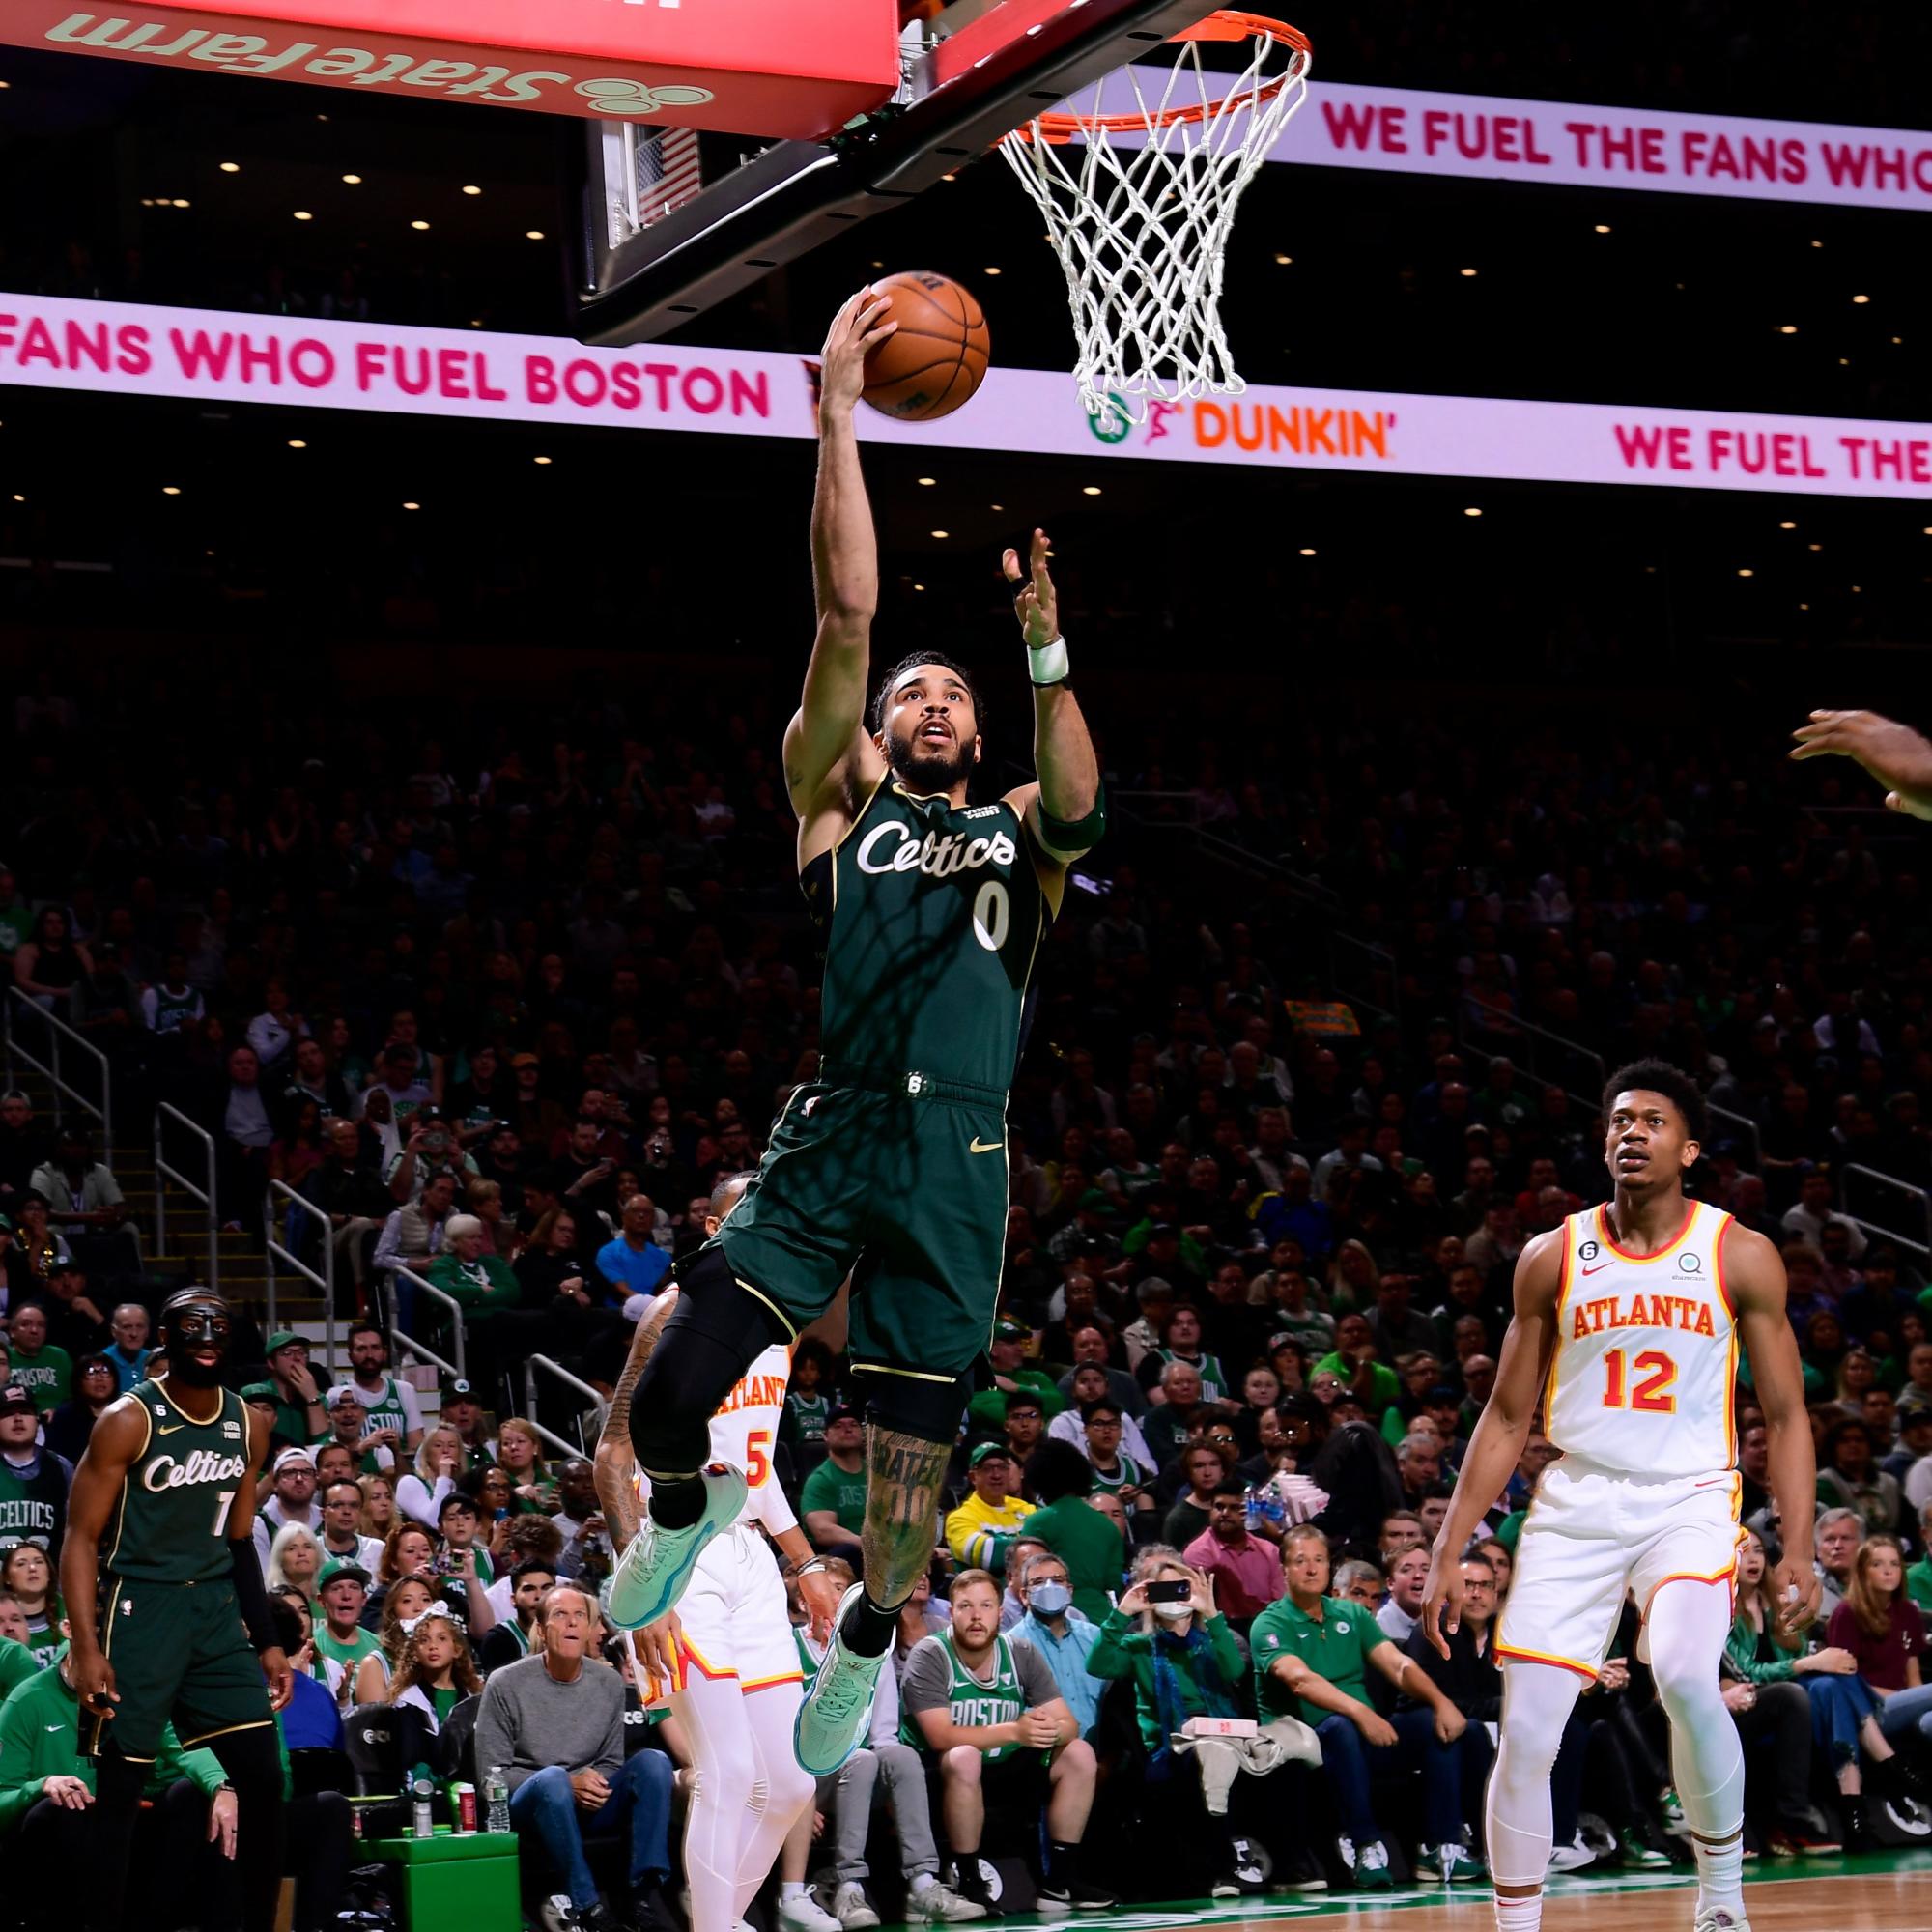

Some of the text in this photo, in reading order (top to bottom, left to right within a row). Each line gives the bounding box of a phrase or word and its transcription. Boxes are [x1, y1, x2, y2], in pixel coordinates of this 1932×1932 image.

[1321, 101, 1406, 154] WE
[1423, 111, 1551, 165] FUEL
[1565, 123, 1666, 174] THE
[1682, 132, 1807, 185] FANS
[168, 328, 334, 387] WHO
[355, 343, 506, 401] FUEL
[525, 355, 768, 417] BOSTON
[1194, 401, 1395, 458] DUNKIN'
[1614, 425, 1932, 483] WE FUEL THE
[857, 820, 1017, 878] Celtics
[973, 881, 1009, 952] 0
[908, 1076, 922, 1093] 6
[1574, 1294, 1716, 1340] ATLANTA
[155, 1404, 167, 1417] 6
[1603, 1349, 1679, 1415] 12
[143, 1450, 245, 1492] Celtics
[746, 1430, 772, 1489] 5
[0, 1499, 54, 1530] CELTICS
[212, 1491, 236, 1537] 7
[951, 1698, 1020, 1727] BOSTON
